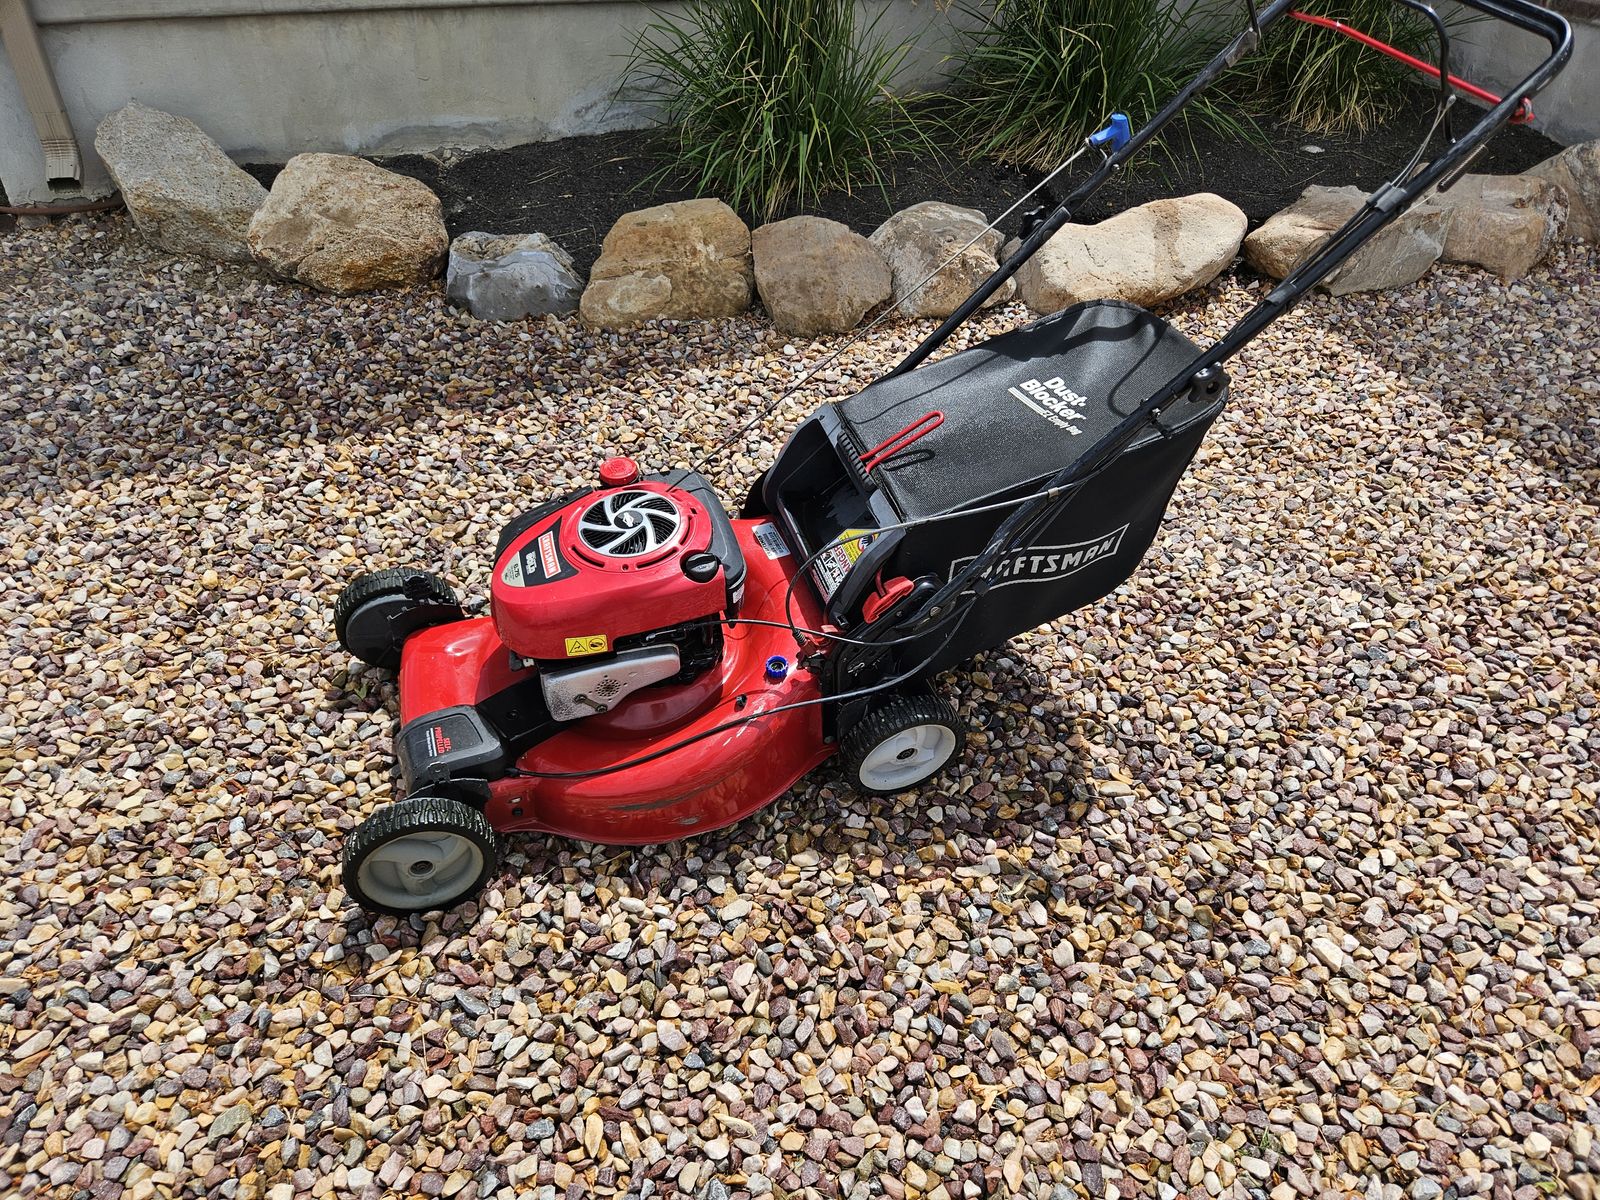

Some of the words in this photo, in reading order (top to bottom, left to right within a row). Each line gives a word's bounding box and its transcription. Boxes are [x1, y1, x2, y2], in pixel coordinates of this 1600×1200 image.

[1019, 378, 1087, 420] Blocker
[542, 535, 557, 574] CRAFTSMAN
[833, 544, 851, 573] ANGER
[957, 535, 1116, 581] AFTSMAN
